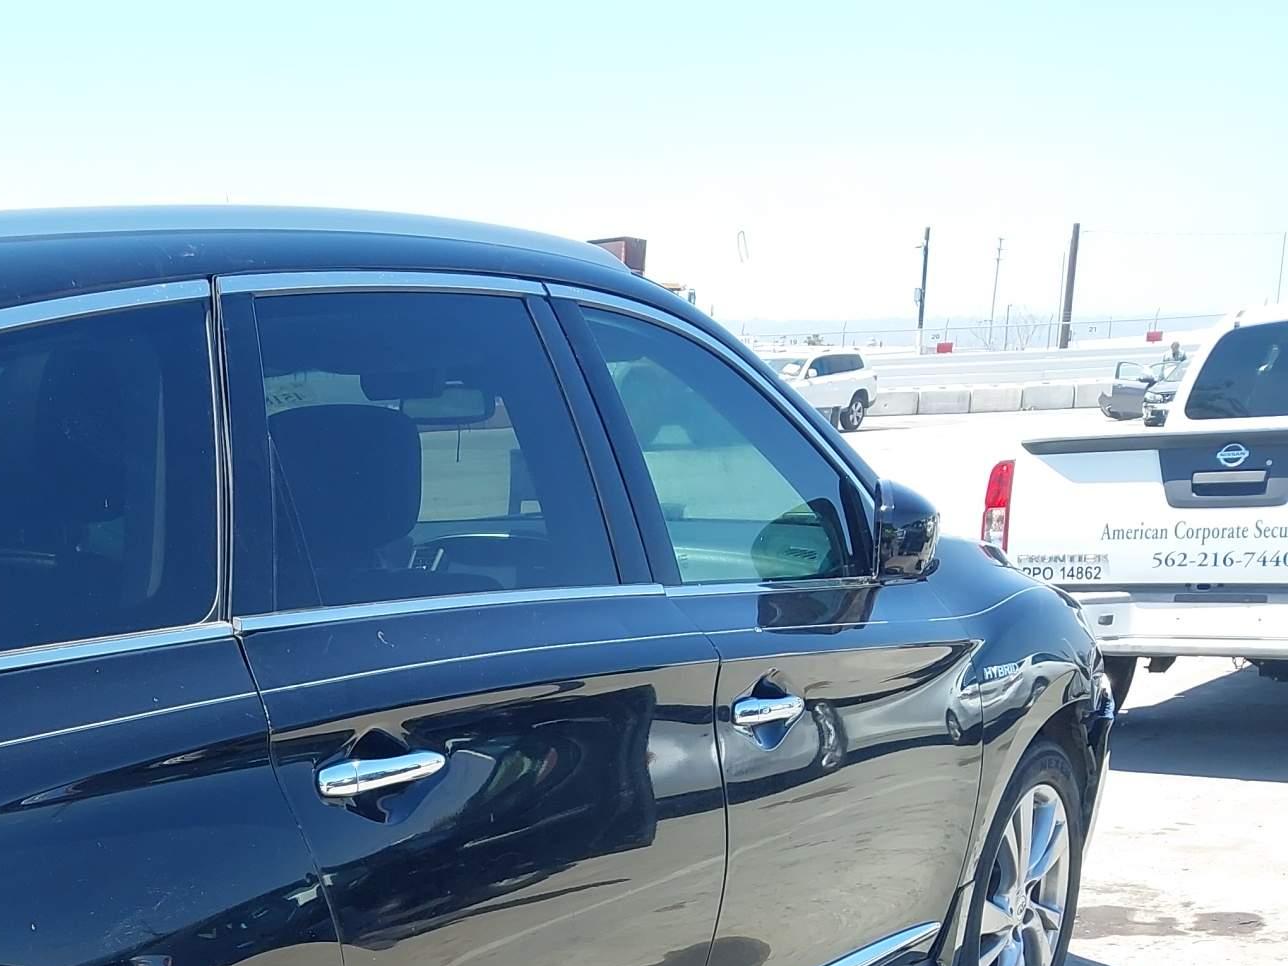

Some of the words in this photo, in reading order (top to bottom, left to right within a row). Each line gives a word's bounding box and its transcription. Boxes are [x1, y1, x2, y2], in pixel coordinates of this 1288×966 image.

[1100, 522, 1168, 541] American
[1174, 519, 1249, 546] Corporate
[1254, 519, 1288, 539] Secu
[1059, 565, 1102, 580] 14862
[983, 662, 1019, 680] HYBRID
